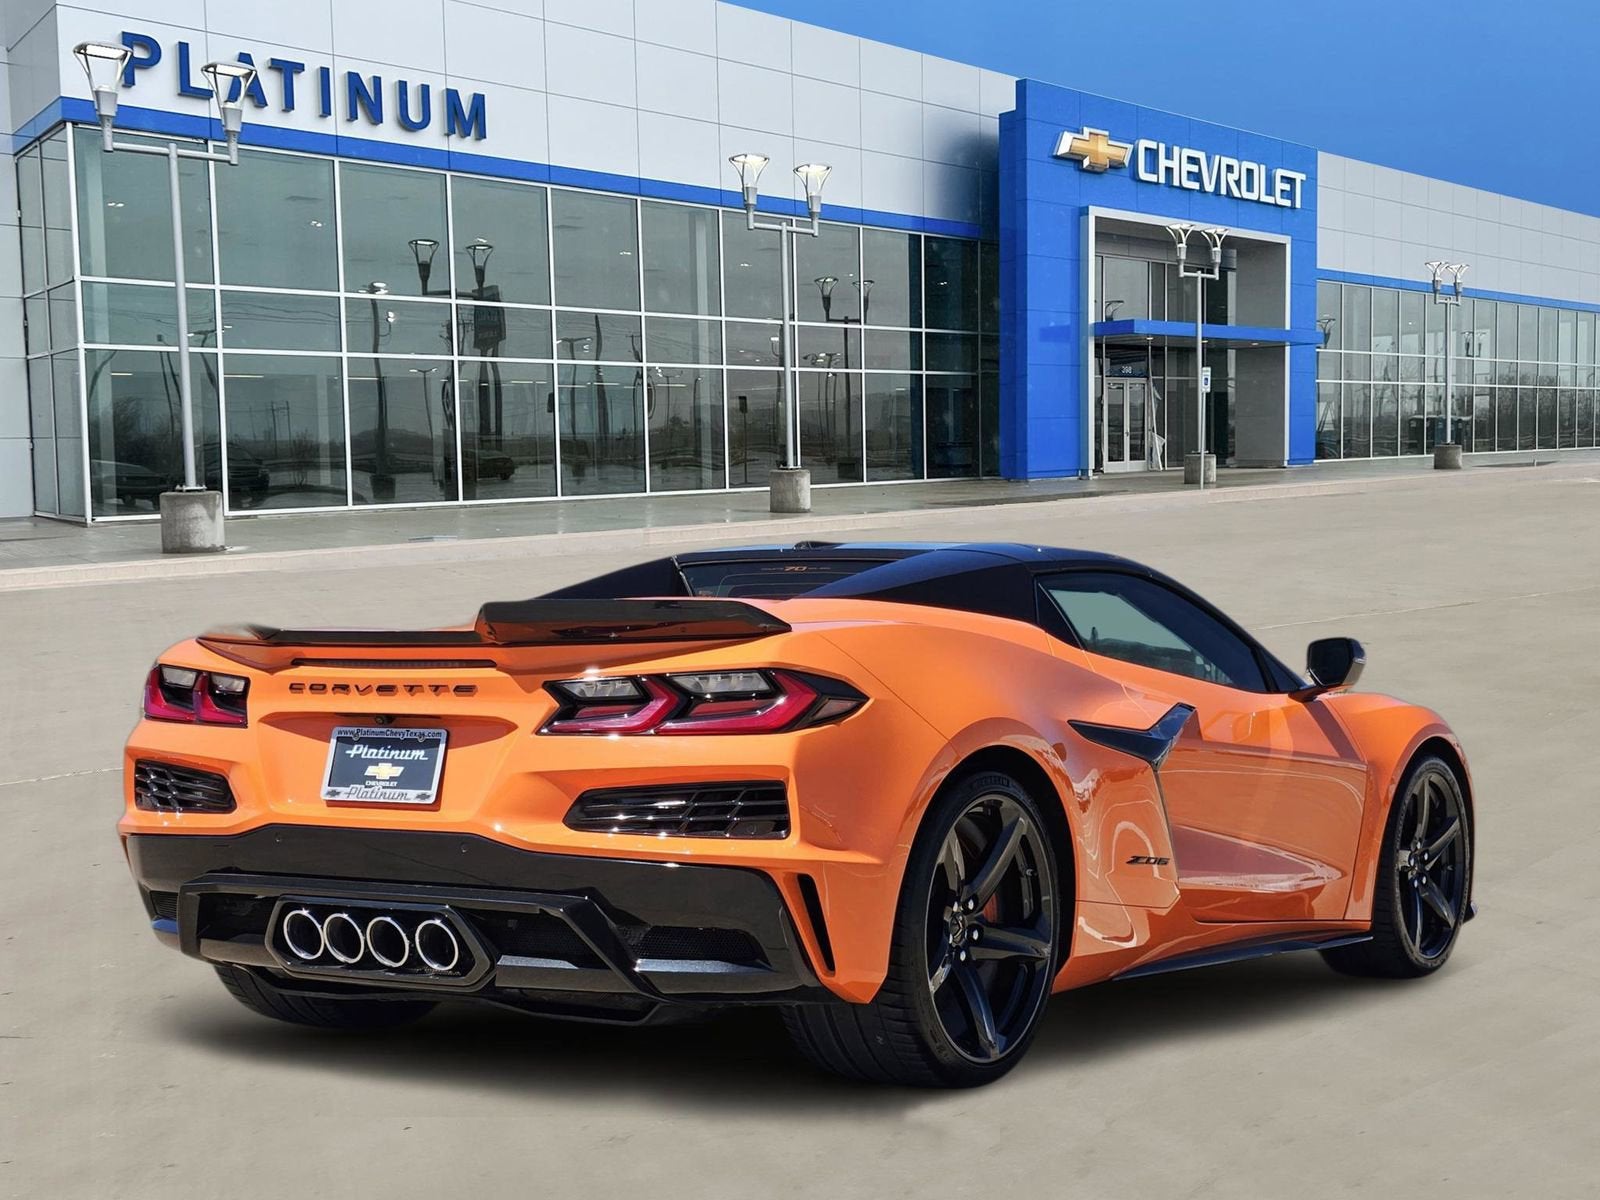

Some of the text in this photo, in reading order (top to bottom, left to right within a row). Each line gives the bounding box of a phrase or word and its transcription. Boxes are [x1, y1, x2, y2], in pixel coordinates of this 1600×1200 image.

[120, 30, 488, 141] PLATINUM
[1136, 138, 1307, 209] CHEVROLET
[288, 682, 479, 696] CORVETTE
[337, 728, 442, 739] www.PlatinumChevyTexas.com
[345, 744, 429, 761] Platinum
[344, 786, 412, 801] Platinum
[1125, 855, 1171, 866] Z06
